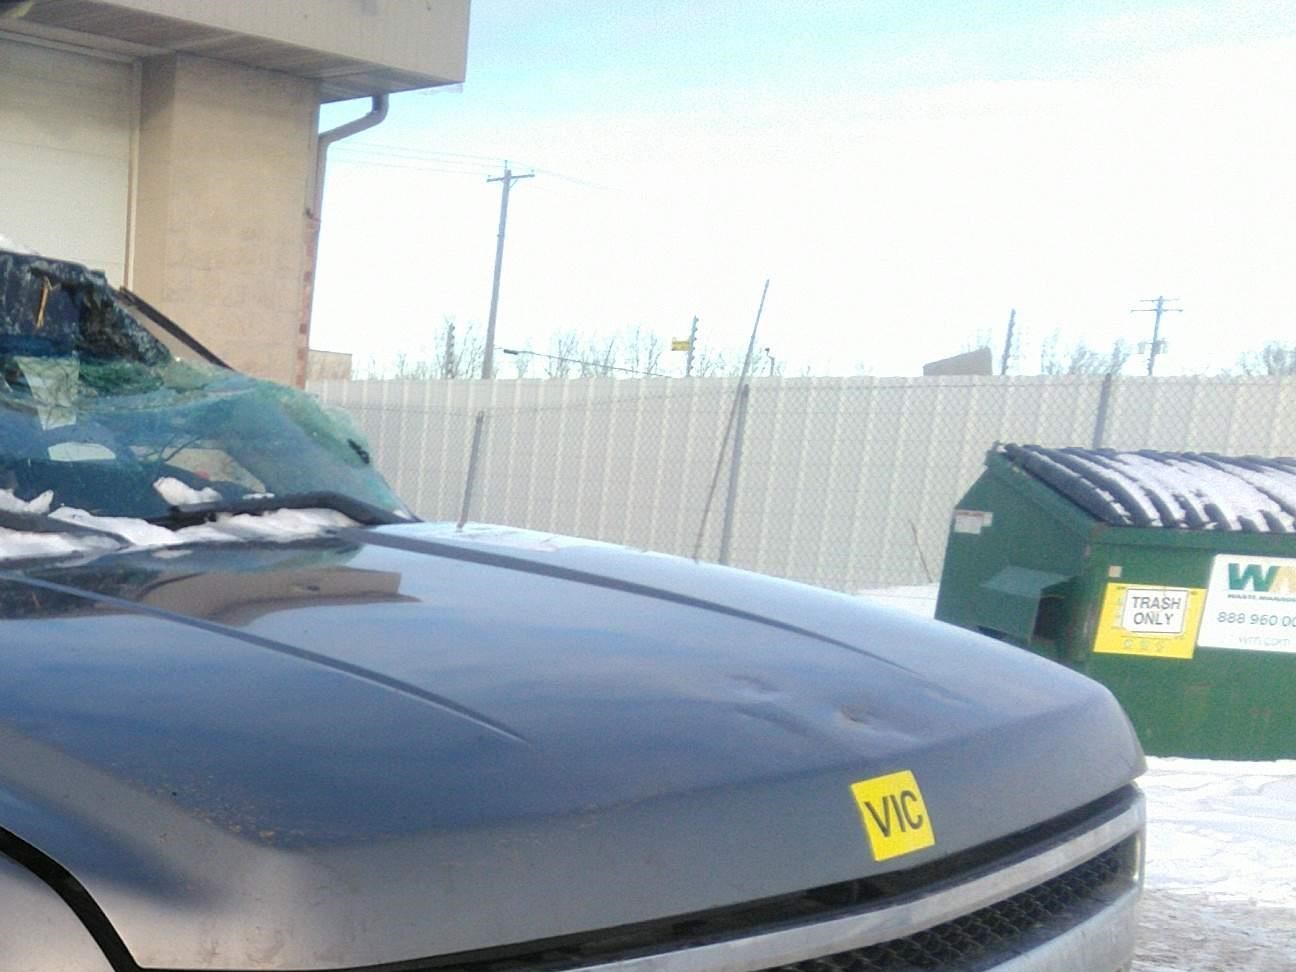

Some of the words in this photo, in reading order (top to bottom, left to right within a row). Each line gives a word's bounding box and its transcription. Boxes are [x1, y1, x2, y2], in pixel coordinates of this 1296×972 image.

[1132, 596, 1181, 610] TRASH
[1133, 612, 1174, 625] ONLY
[1217, 611, 1246, 624] 888
[1250, 613, 1278, 626] 960
[864, 790, 923, 838] VIC
